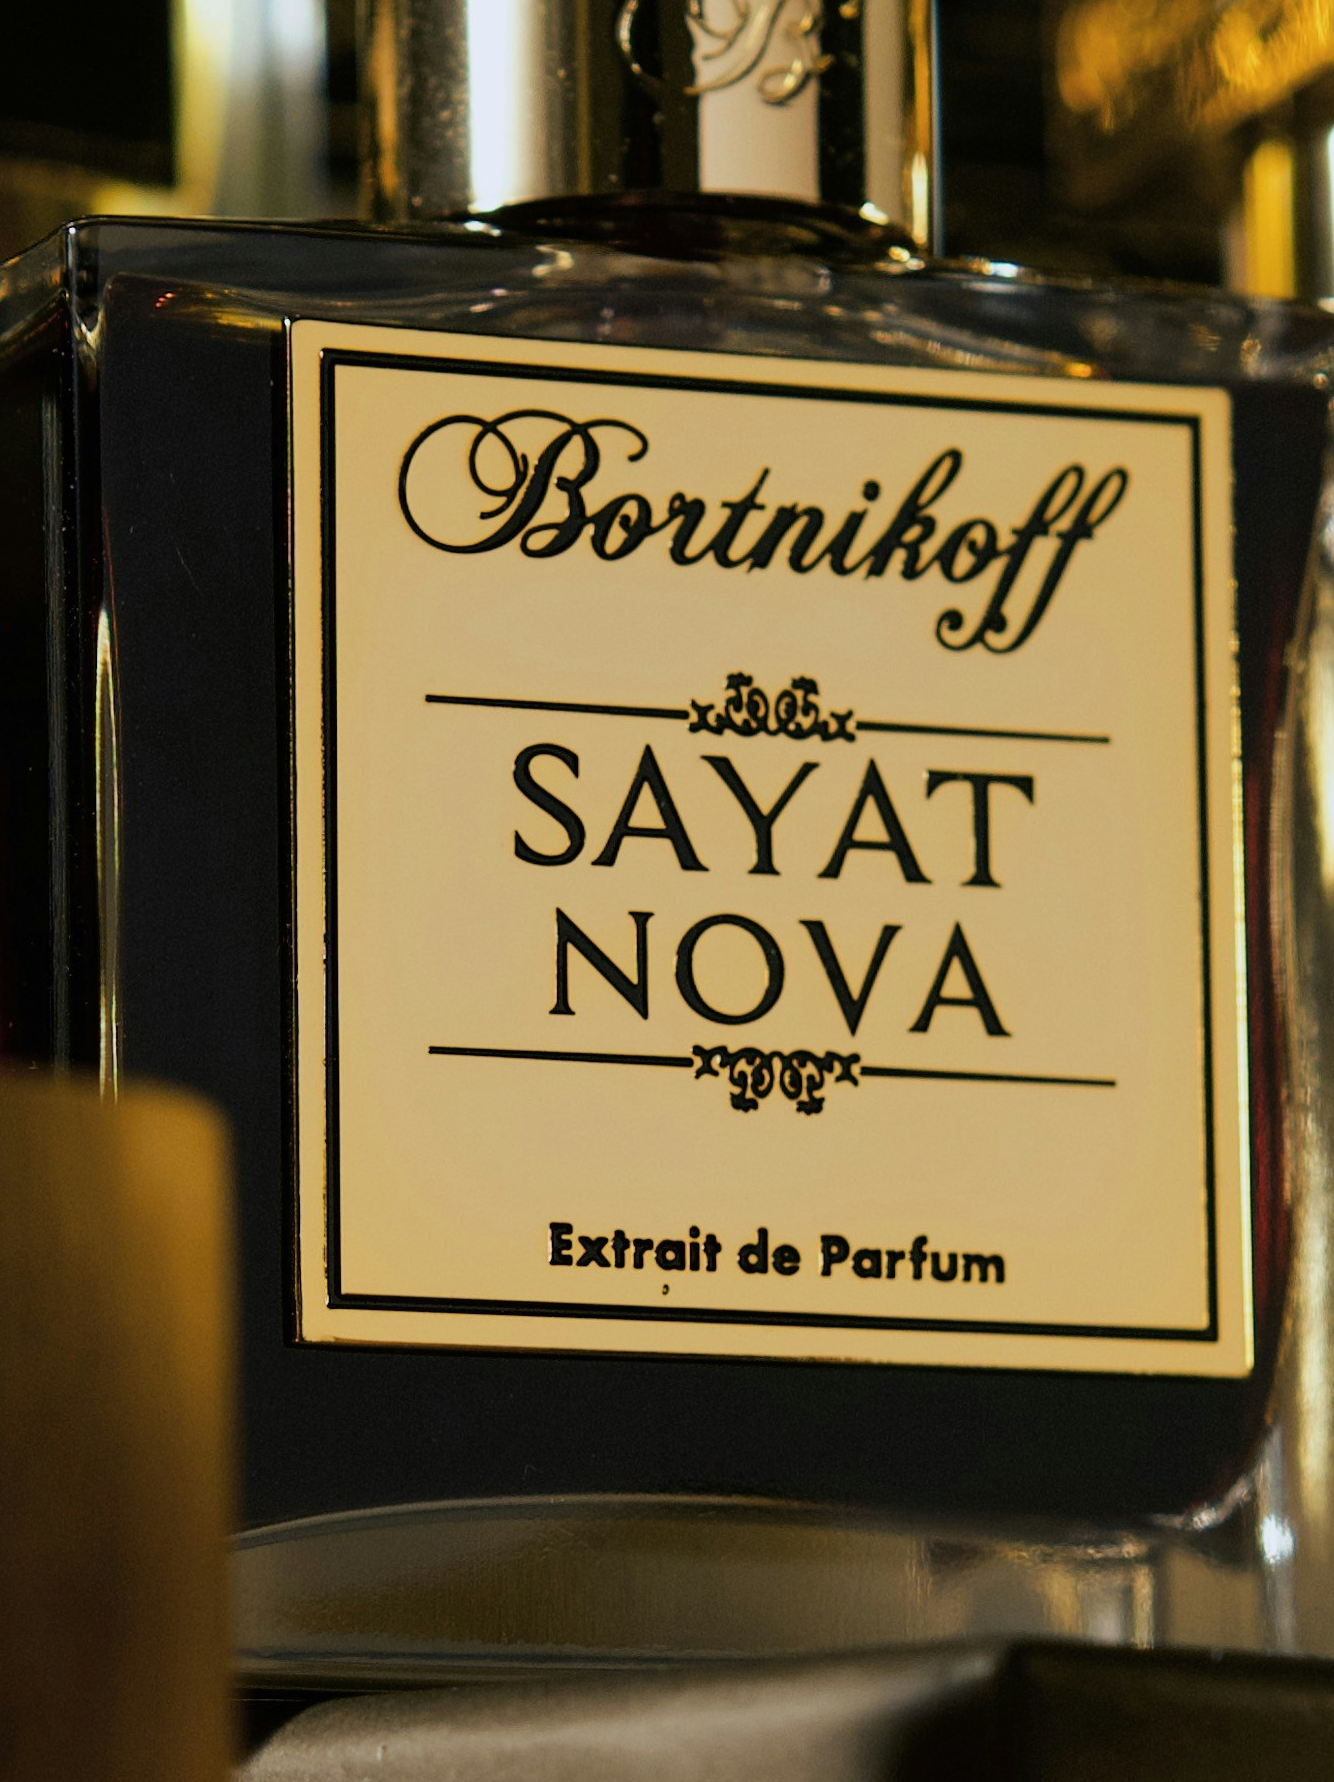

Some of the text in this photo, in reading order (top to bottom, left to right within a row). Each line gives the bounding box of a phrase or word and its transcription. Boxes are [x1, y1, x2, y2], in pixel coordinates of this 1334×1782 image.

[398, 408, 1130, 654] Bortnikoff
[512, 741, 1035, 889] SAYAT
[548, 906, 1012, 1038] NOVA
[548, 1222, 1007, 1285] Extrait de Parfum
